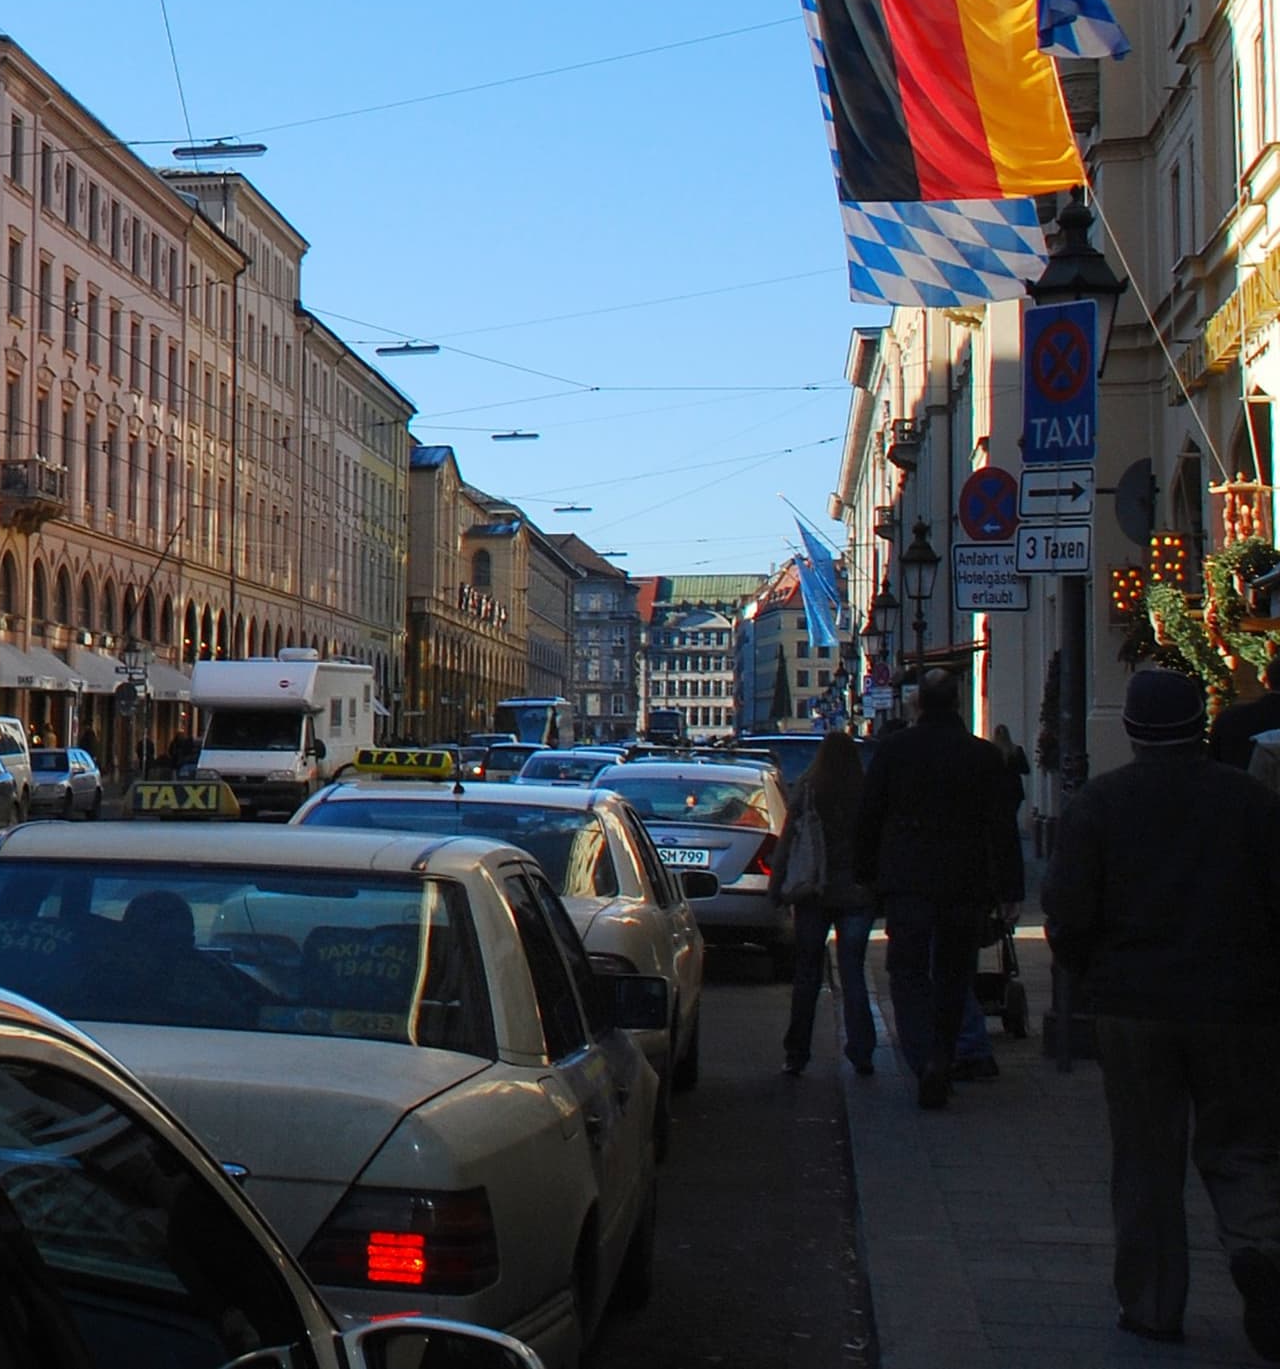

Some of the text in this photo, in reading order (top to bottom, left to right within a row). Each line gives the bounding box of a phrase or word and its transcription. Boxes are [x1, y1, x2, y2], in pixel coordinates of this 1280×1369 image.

[1030, 414, 1090, 450] TAXI
[1025, 536, 1085, 560] 3 Taxen
[958, 551, 1000, 566] Anfahrt
[971, 590, 1014, 604] erlaubt
[369, 751, 433, 766] TAXI
[136, 785, 217, 810] TAXI
[680, 850, 704, 863] 799
